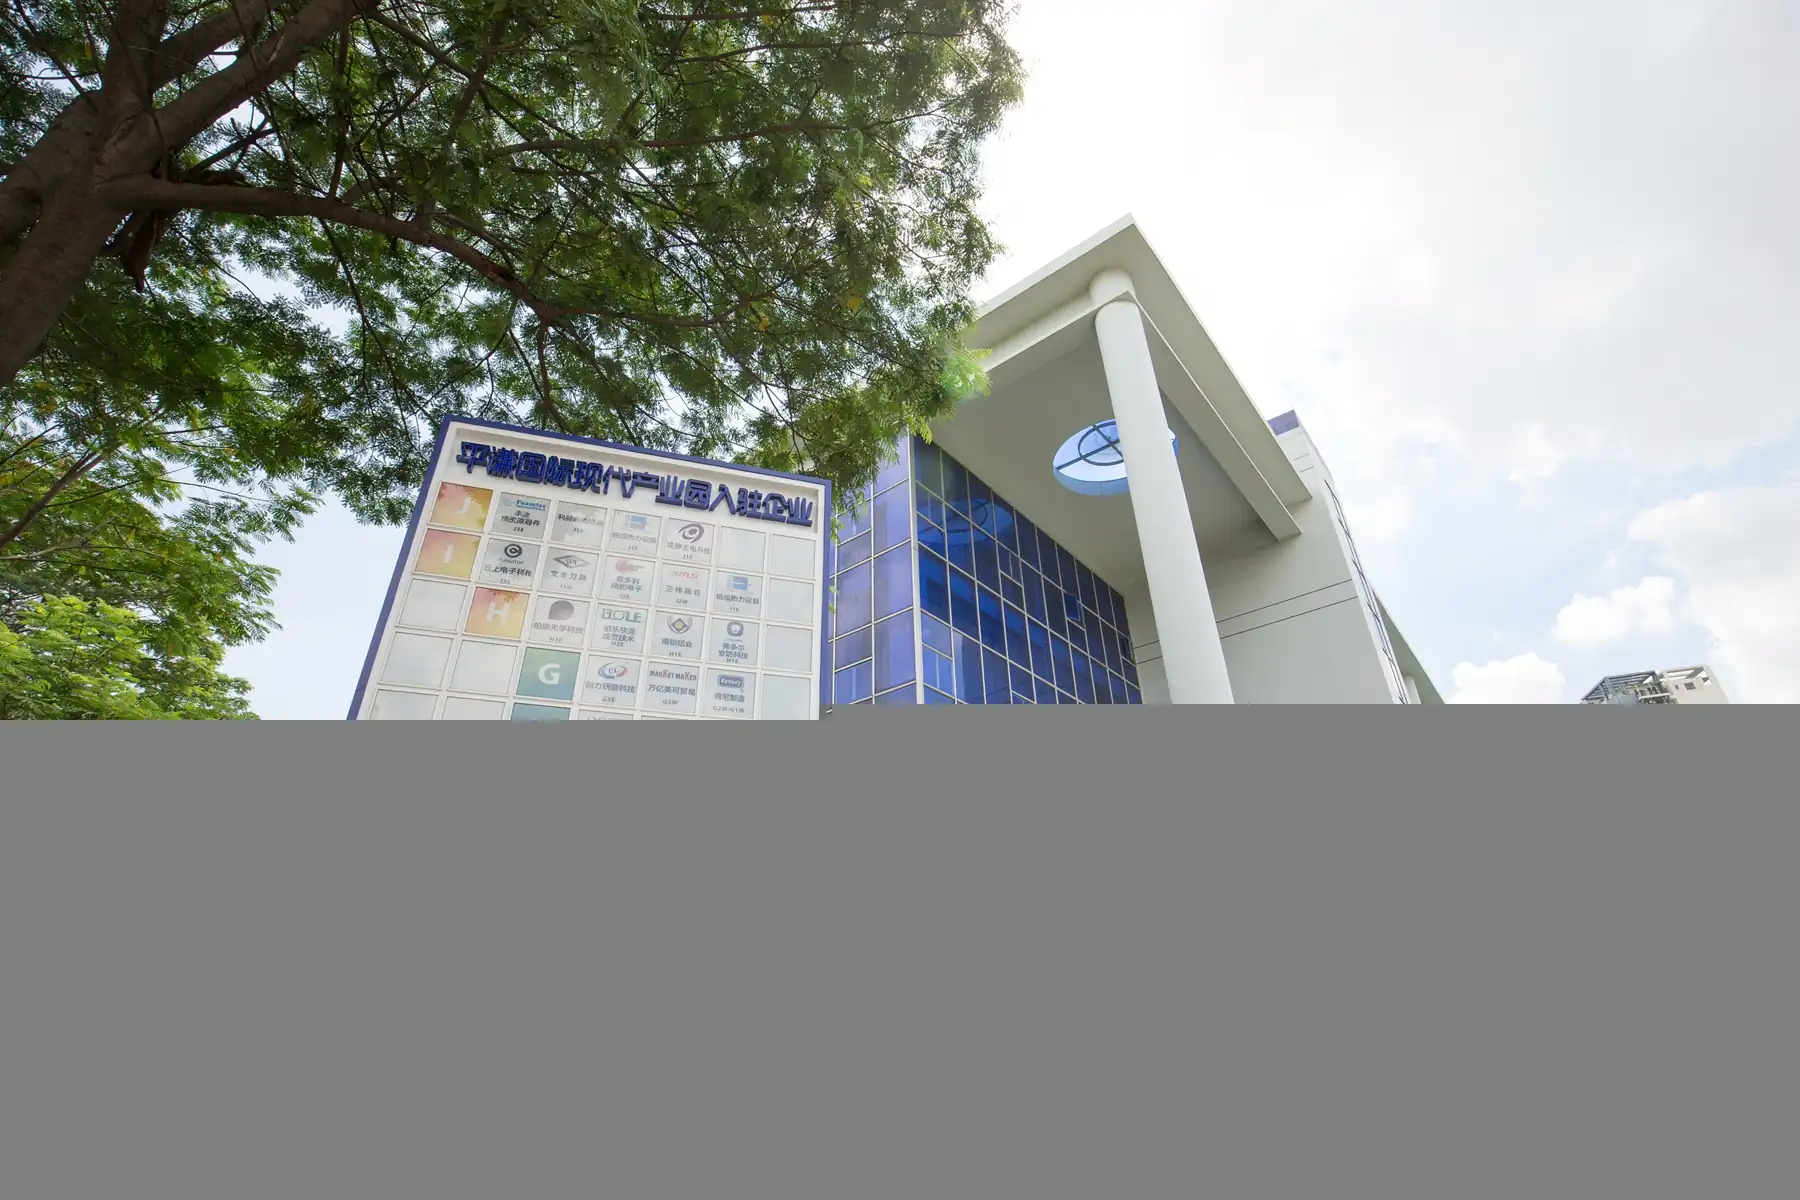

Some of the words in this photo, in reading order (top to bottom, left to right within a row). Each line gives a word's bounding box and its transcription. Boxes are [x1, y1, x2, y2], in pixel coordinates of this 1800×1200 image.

[486, 601, 511, 626] H
[538, 663, 561, 685] G
[720, 676, 743, 687] Kenney
